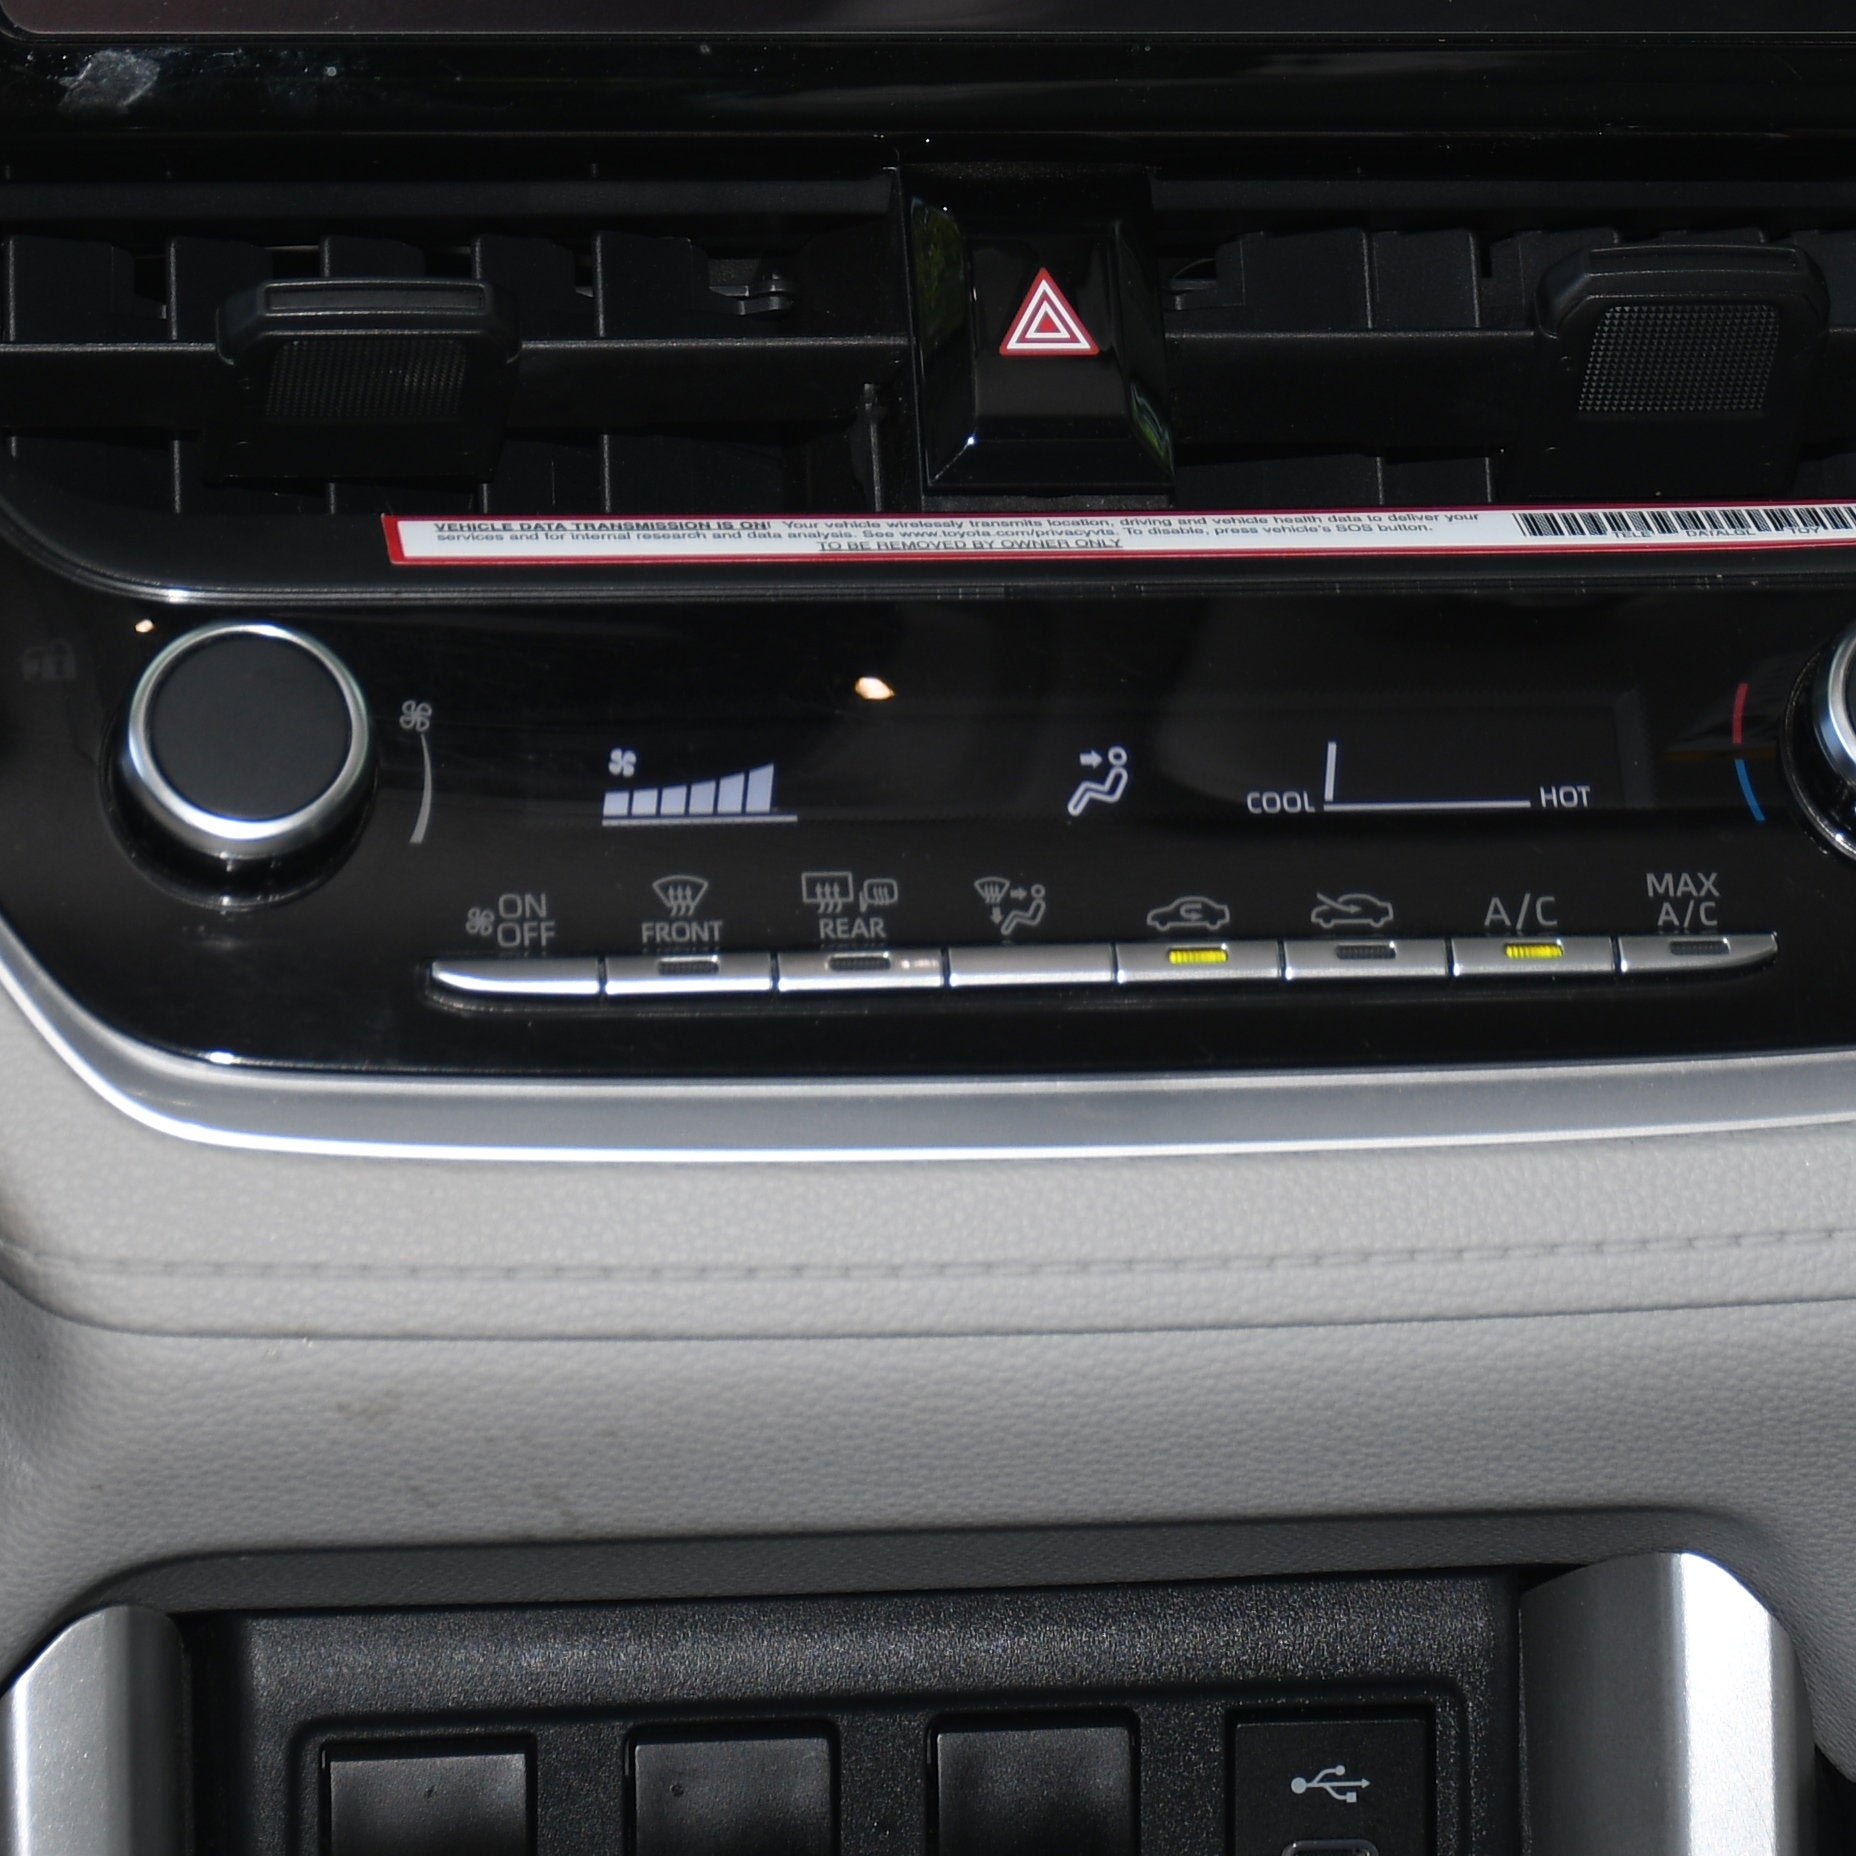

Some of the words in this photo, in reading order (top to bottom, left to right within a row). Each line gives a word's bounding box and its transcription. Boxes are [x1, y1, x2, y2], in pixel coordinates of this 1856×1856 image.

[434, 523, 514, 532] VEHICLE
[519, 523, 568, 532] DATA
[574, 522, 710, 532] TRANSMISSION
[717, 522, 734, 530] IS
[782, 521, 819, 529] Your
[825, 521, 881, 529] vehicle
[888, 520, 964, 529] wirelessly
[969, 519, 1042, 527] transmits
[1120, 518, 1172, 527] driving
[1178, 517, 1207, 525] and
[1211, 517, 1268, 525] vehicle
[1273, 516, 1322, 524] health
[1327, 515, 1362, 523] data
[1368, 514, 1383, 522] to
[1444, 514, 1479, 522] your
[437, 533, 504, 541] services
[509, 532, 539, 540] and
[544, 532, 565, 540] for
[572, 532, 630, 540] internal
[637, 531, 706, 540] research
[712, 531, 742, 539] and
[747, 531, 782, 539] data
[788, 530, 856, 539] analysis.
[862, 530, 894, 538] See
[1148, 527, 1209, 535] disable,
[1214, 527, 1258, 535] press
[1263, 525, 1331, 533] vehicle's
[1336, 524, 1373, 532] SOS
[1377, 523, 1433, 531] button.
[817, 541, 842, 551] TO
[847, 541, 871, 551] BE
[876, 540, 966, 550] REMOVED
[972, 540, 994, 549] BY
[1001, 539, 1070, 549] OWNER
[1075, 538, 1122, 548] ONLY
[1613, 531, 1655, 539] TELE
[1247, 792, 1315, 814] COOL
[1540, 786, 1591, 809] HOT
[1645, 872, 1721, 899] MAX
[499, 895, 548, 918] ON
[1485, 895, 1558, 927] A/C
[1657, 900, 1719, 927] A/C
[497, 922, 555, 946] OFF
[642, 921, 724, 944] FRONT
[819, 917, 886, 939] REAR
